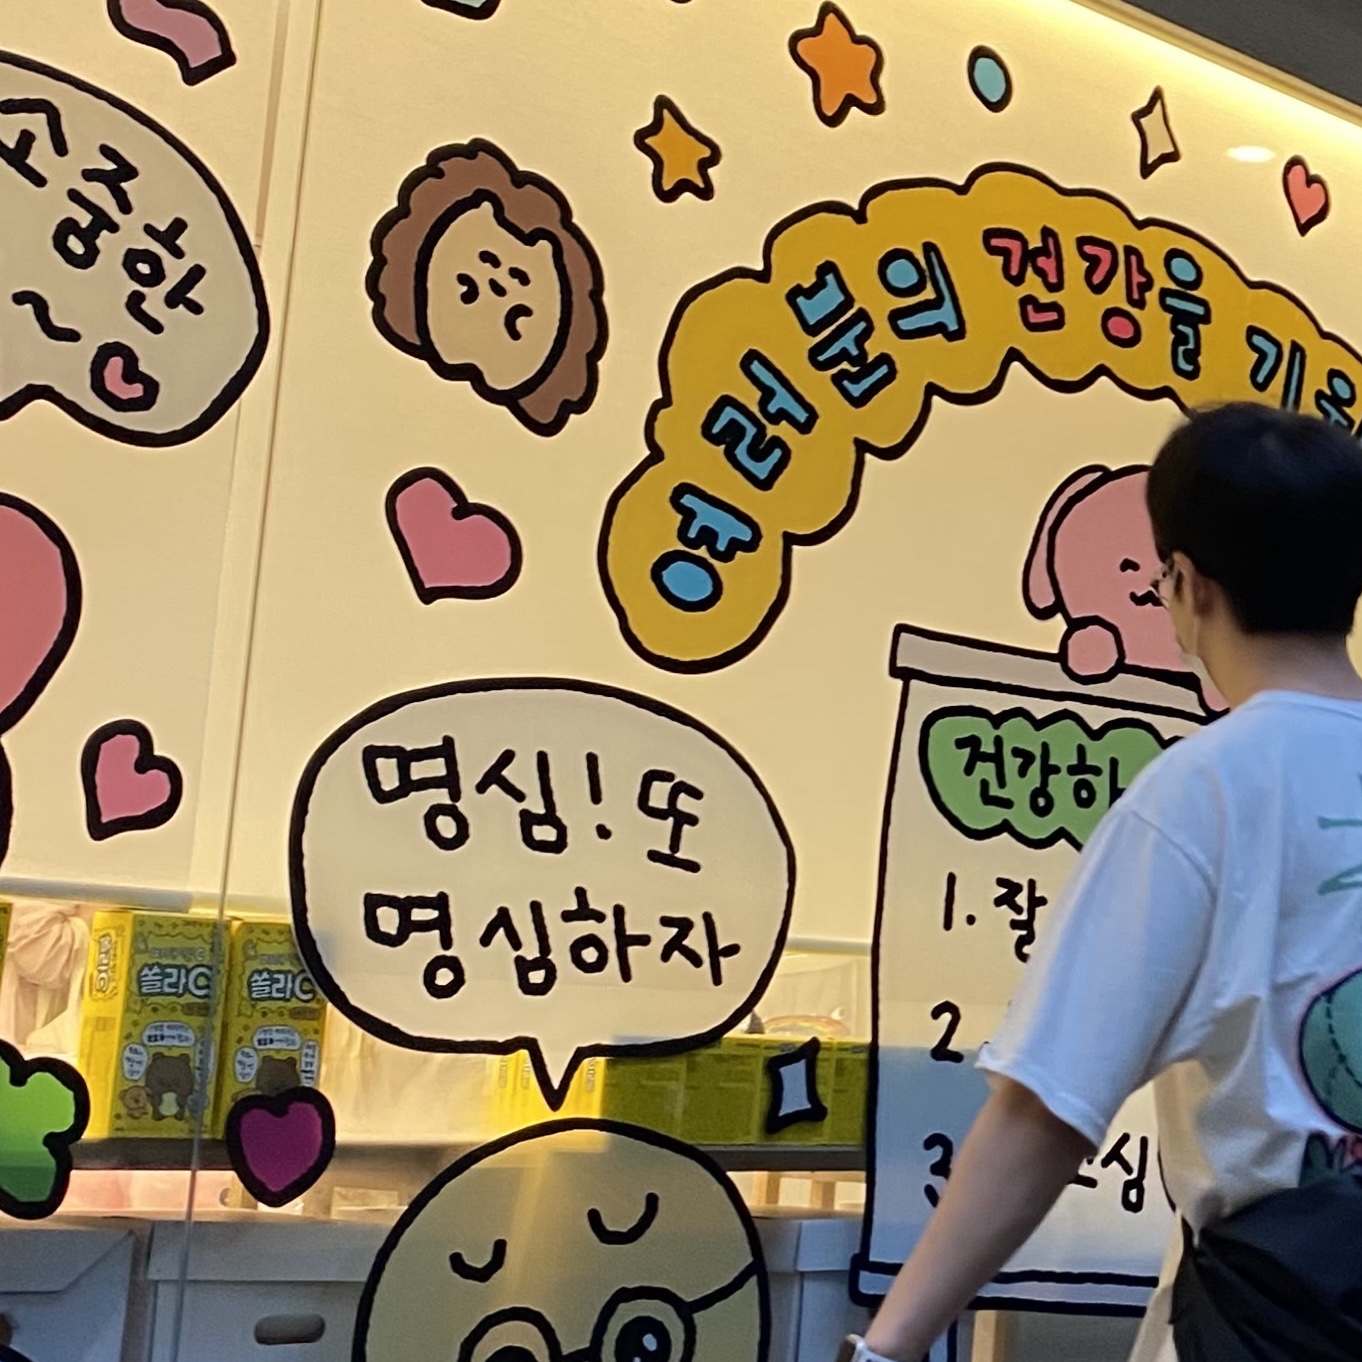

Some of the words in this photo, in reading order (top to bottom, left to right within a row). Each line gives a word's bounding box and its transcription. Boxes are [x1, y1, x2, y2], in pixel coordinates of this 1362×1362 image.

[0, 98, 206, 335] 소중한
[650, 241, 966, 613] 여러분의
[983, 225, 1211, 380] 건강을
[363, 886, 741, 1000] 명심하자
[993, 876, 1049, 964] 잘
[138, 963, 213, 997] 쏠라C
[249, 968, 317, 1001] 쏠라C
